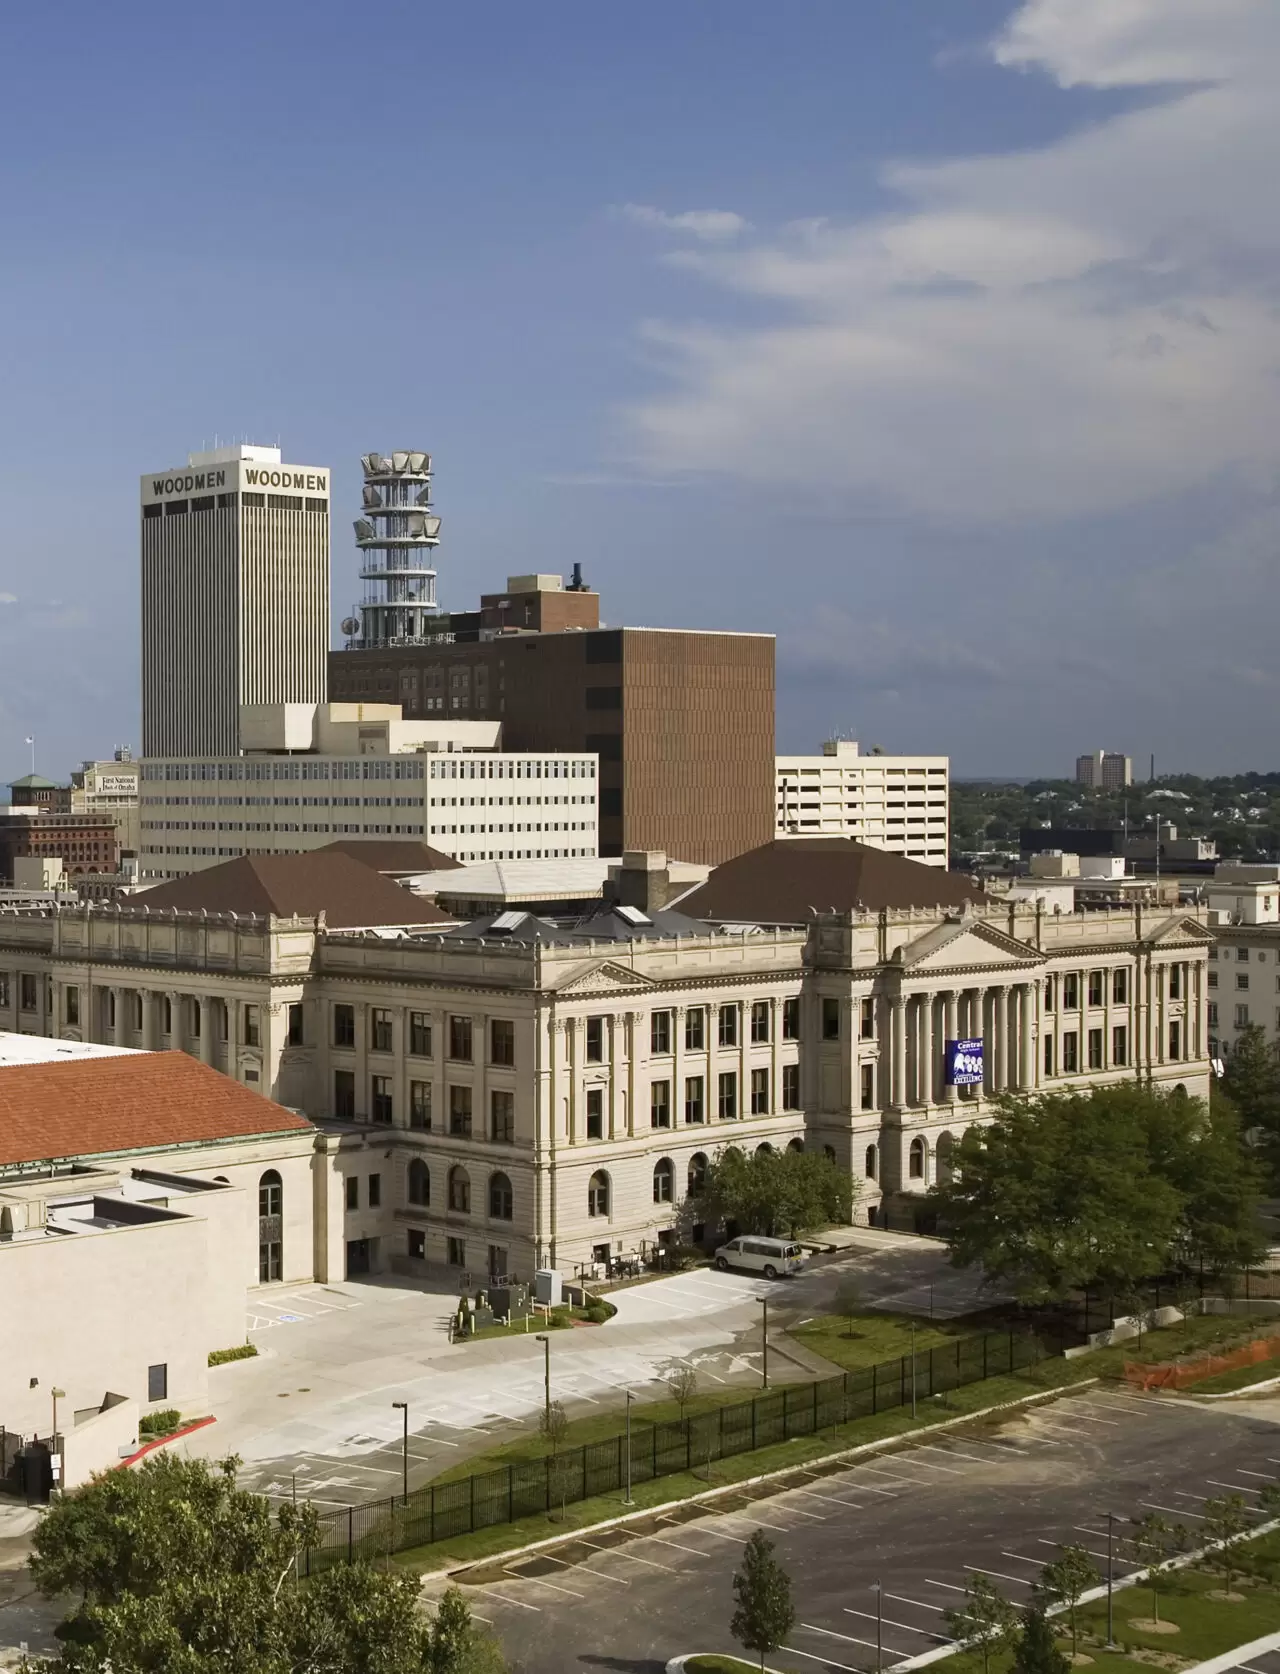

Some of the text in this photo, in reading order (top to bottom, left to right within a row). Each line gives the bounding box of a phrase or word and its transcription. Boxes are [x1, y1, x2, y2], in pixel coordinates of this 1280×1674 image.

[153, 470, 225, 496] WOODMEN
[245, 469, 326, 491] WOODMEN
[115, 776, 135, 784] National
[958, 1040, 983, 1049] Central
